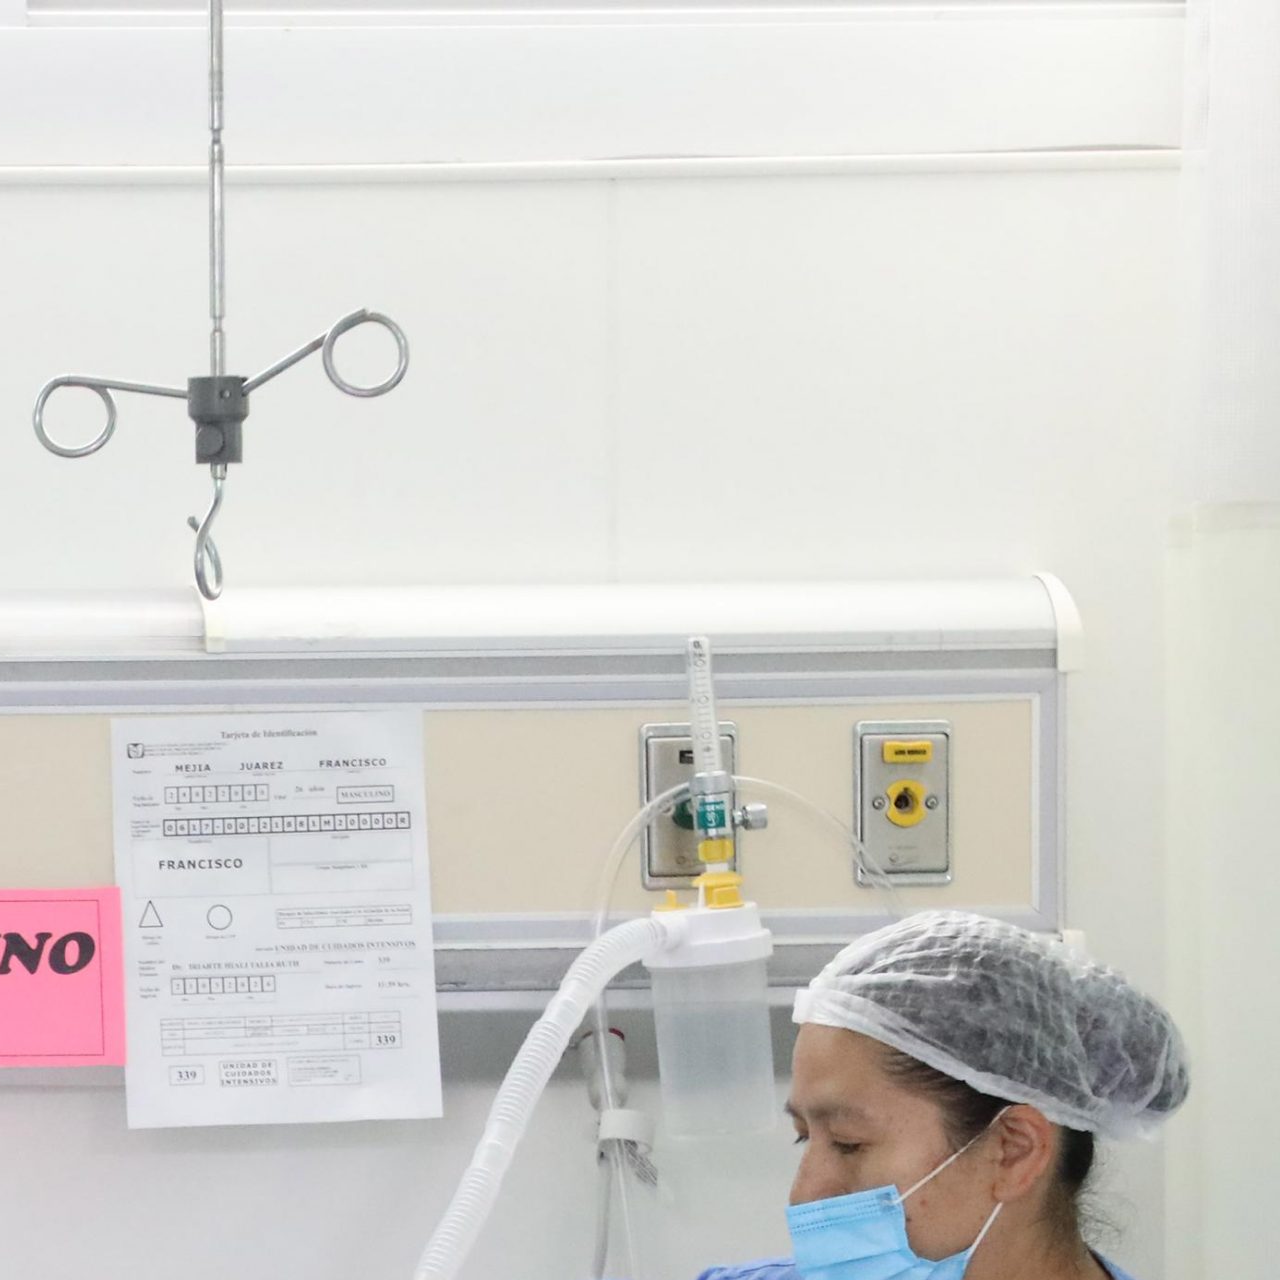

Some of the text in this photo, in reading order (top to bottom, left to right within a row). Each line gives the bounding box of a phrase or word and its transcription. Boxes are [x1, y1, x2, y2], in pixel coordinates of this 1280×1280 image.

[221, 731, 249, 740] Tarjeta
[175, 758, 387, 773] MEJIA JUAREZ FRANCISCO
[158, 858, 244, 870] FRANCISCO
[376, 1034, 396, 1046] 339
[222, 1061, 272, 1070] UNIDAD DE
[177, 1070, 197, 1081] 339
[224, 1069, 272, 1078] CUIDADOS
[221, 1078, 277, 1087] INTENSIVOS
